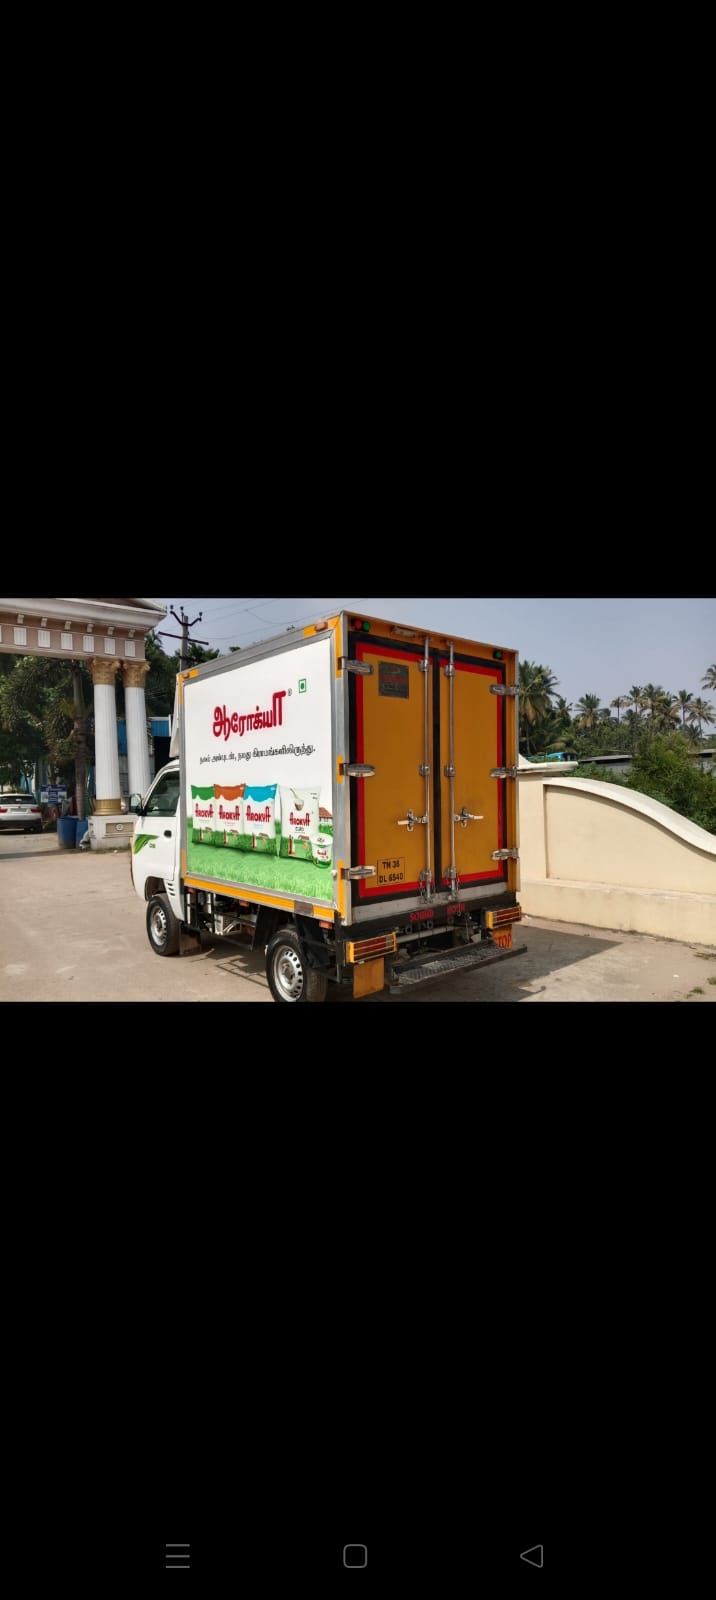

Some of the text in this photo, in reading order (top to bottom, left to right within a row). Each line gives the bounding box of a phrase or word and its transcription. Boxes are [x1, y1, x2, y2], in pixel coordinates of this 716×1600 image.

[213, 690, 286, 741] ஆரோக்யா
[382, 861, 391, 869] TN
[379, 872, 403, 883] DL 6540
